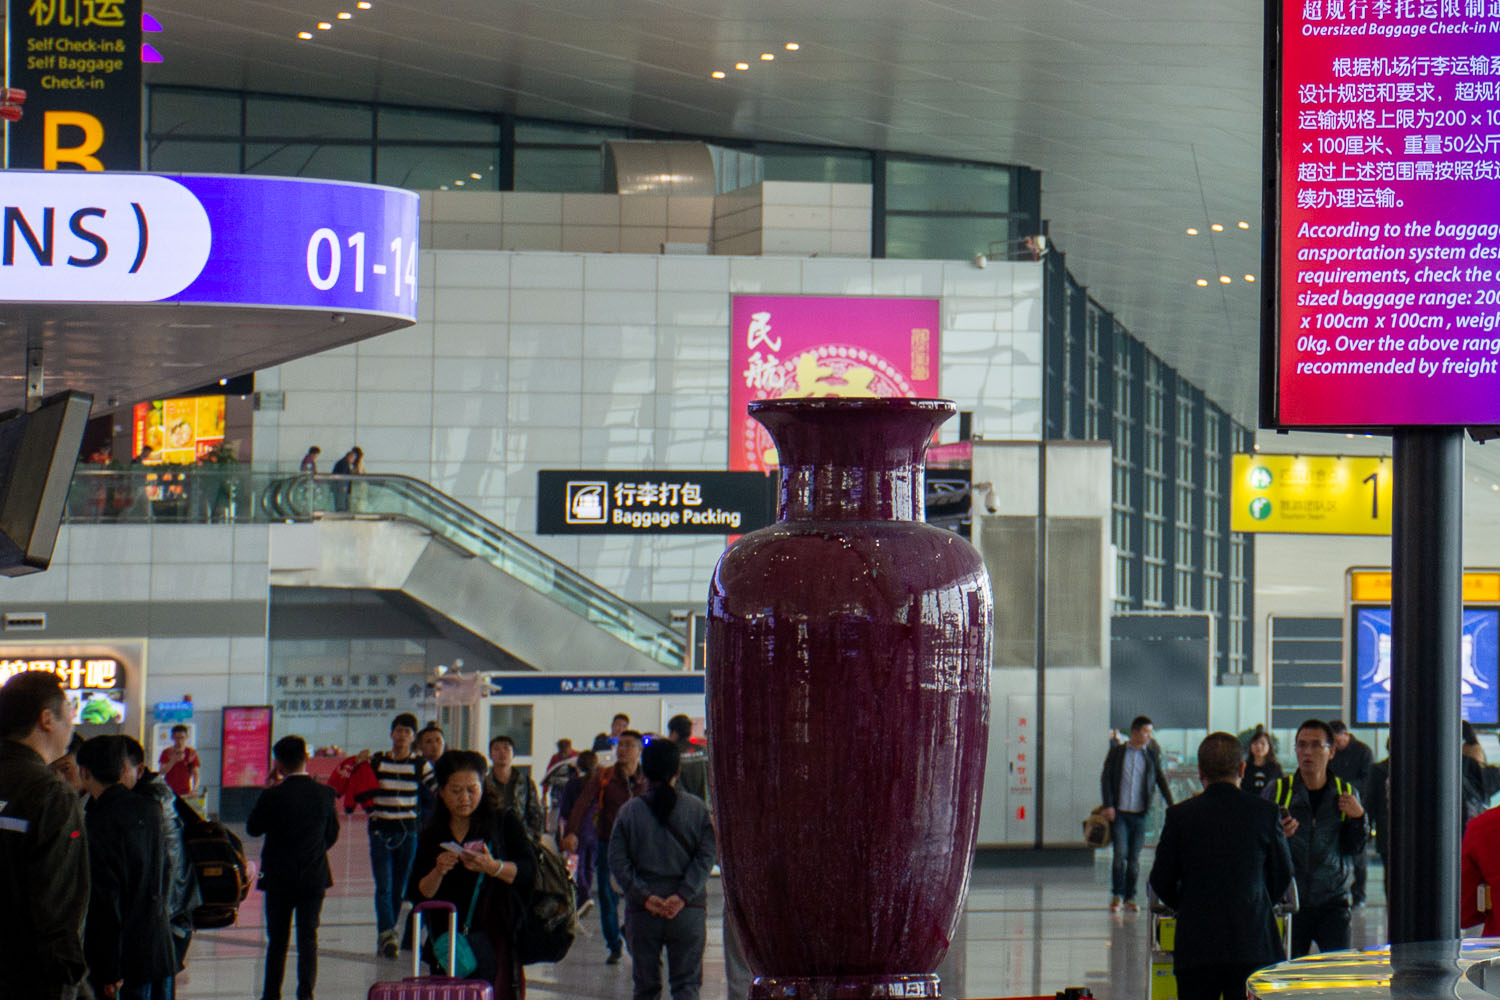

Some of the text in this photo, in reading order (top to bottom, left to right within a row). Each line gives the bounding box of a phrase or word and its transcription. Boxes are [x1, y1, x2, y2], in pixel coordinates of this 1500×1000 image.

[1302, 22, 1367, 36] Oversized
[1368, 23, 1427, 38] Baggage
[1429, 21, 1486, 34] Check-in
[27, 38, 53, 52] Self
[27, 55, 123, 73] Self Baggage
[41, 74, 104, 89] Check-in
[1297, 187, 1404, 209] 续办理运输。
[1297, 221, 1380, 241] According
[1384, 223, 1401, 237] to
[1405, 221, 1431, 237] the
[1298, 244, 1405, 264] ansportation
[1408, 245, 1466, 264] system
[1298, 267, 1410, 287] requirements,
[1414, 266, 1462, 282] check
[1465, 266, 1492, 282] the
[1297, 289, 1340, 306] sized
[1342, 289, 1415, 310] baggage
[1418, 293, 1472, 309] range:
[1316, 313, 1368, 328] 100cm
[744, 312, 785, 388] 民航
[1297, 335, 1331, 355] 0kg.
[1335, 336, 1375, 351] Over
[1378, 335, 1405, 351] the
[1408, 334, 1459, 351] above
[1297, 357, 1416, 374] recommended
[1418, 357, 1439, 378] by
[1442, 357, 1498, 378] freight
[614, 482, 702, 506] 行李打包
[1363, 472, 1378, 519] 1
[613, 508, 741, 528] Baggage Packing
